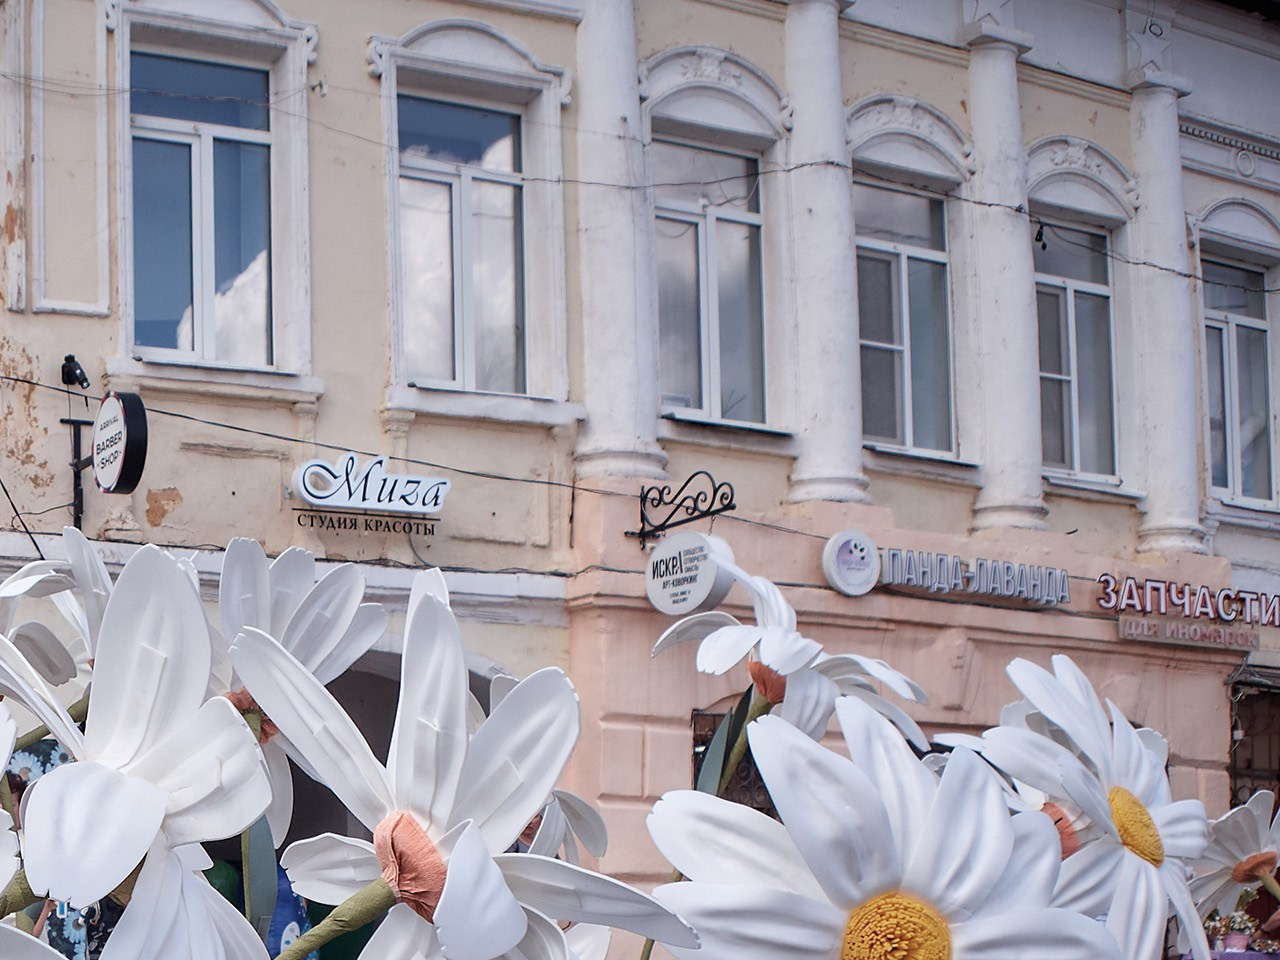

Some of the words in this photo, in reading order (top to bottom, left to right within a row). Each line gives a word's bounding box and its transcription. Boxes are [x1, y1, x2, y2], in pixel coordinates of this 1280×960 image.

[100, 415, 119, 431] ARRIVAL
[96, 431, 123, 455] BARBER
[100, 450, 119, 469] SHOP
[302, 456, 448, 508] Muza
[297, 514, 358, 531] СТУДИЯ
[364, 518, 436, 536] КРАСОТЫ
[887, 548, 1071, 606] ПАНДА-ЛАВАНДА
[1096, 573, 1280, 628] ЗАПЧАСТИ
[1124, 619, 1158, 638] для
[1166, 623, 1259, 647] иномарок
